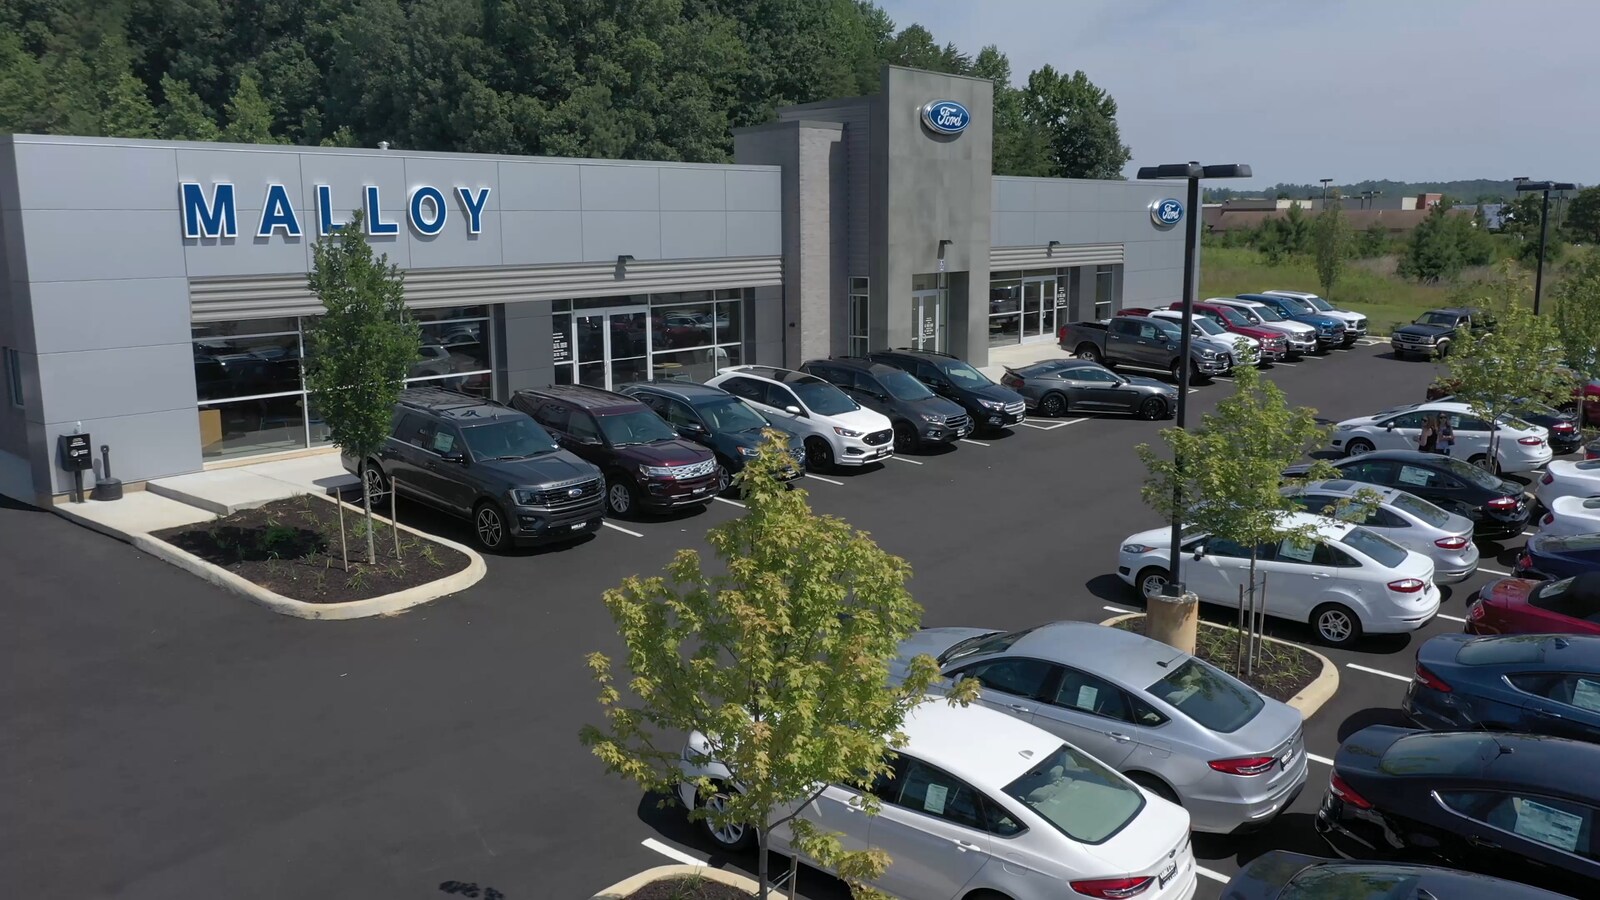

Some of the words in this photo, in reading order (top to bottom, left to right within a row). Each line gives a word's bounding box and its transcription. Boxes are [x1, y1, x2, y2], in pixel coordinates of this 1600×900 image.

[937, 106, 963, 127] Ford
[180, 182, 491, 238] MALLOY
[1162, 203, 1180, 220] Ford
